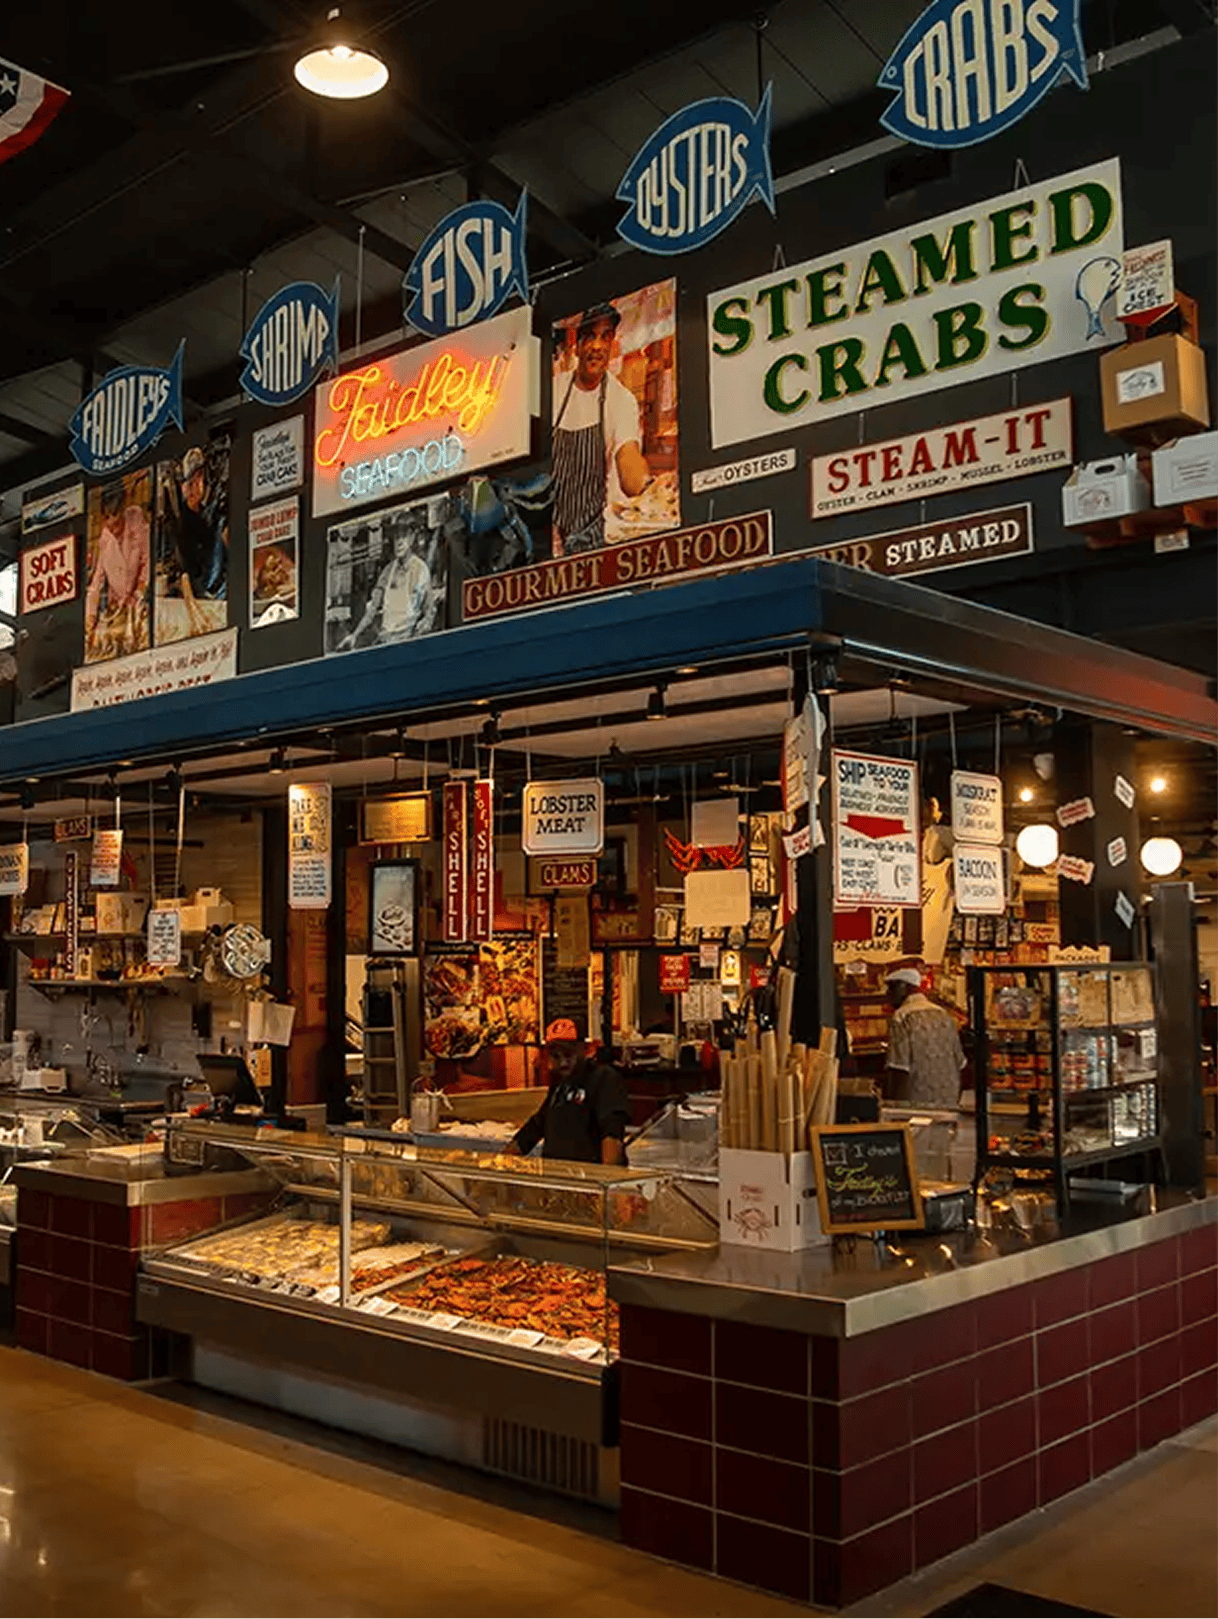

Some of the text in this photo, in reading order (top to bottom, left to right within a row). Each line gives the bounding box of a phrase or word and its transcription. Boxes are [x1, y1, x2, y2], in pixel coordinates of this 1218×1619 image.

[903, 0, 1059, 132] CRABS
[635, 121, 750, 238] OYSTERS
[421, 217, 513, 328] FISH
[712, 181, 1114, 357] STEAMED
[251, 300, 330, 393] SHRIMP
[762, 283, 1050, 415] CRABS
[81, 374, 171, 457] FAIDLEY'S
[92, 443, 139, 471] SEAFOOD
[340, 434, 464, 499] SEAFOOD
[724, 454, 788, 481] OYSTERS
[817, 496, 855, 511] OYSTER
[866, 487, 895, 501] CLAM
[906, 475, 948, 493] SHRIMP
[1015, 450, 1067, 470] LOBSTER
[826, 408, 1053, 493] STEAM-IT
[30, 545, 67, 578] SOFT
[465, 518, 766, 614] GOURMET SEAFOOD
[885, 519, 1020, 568] STEAMED
[26, 571, 74, 605] CRABS
[531, 794, 598, 816] LOBSTER
[838, 760, 910, 786] SHIP SEAFOOD
[873, 777, 910, 793] TO YOUR
[536, 817, 586, 835] MEAT
[448, 830, 460, 937] SHELL
[476, 829, 488, 936] SHELL
[543, 863, 590, 885] CLAMS
